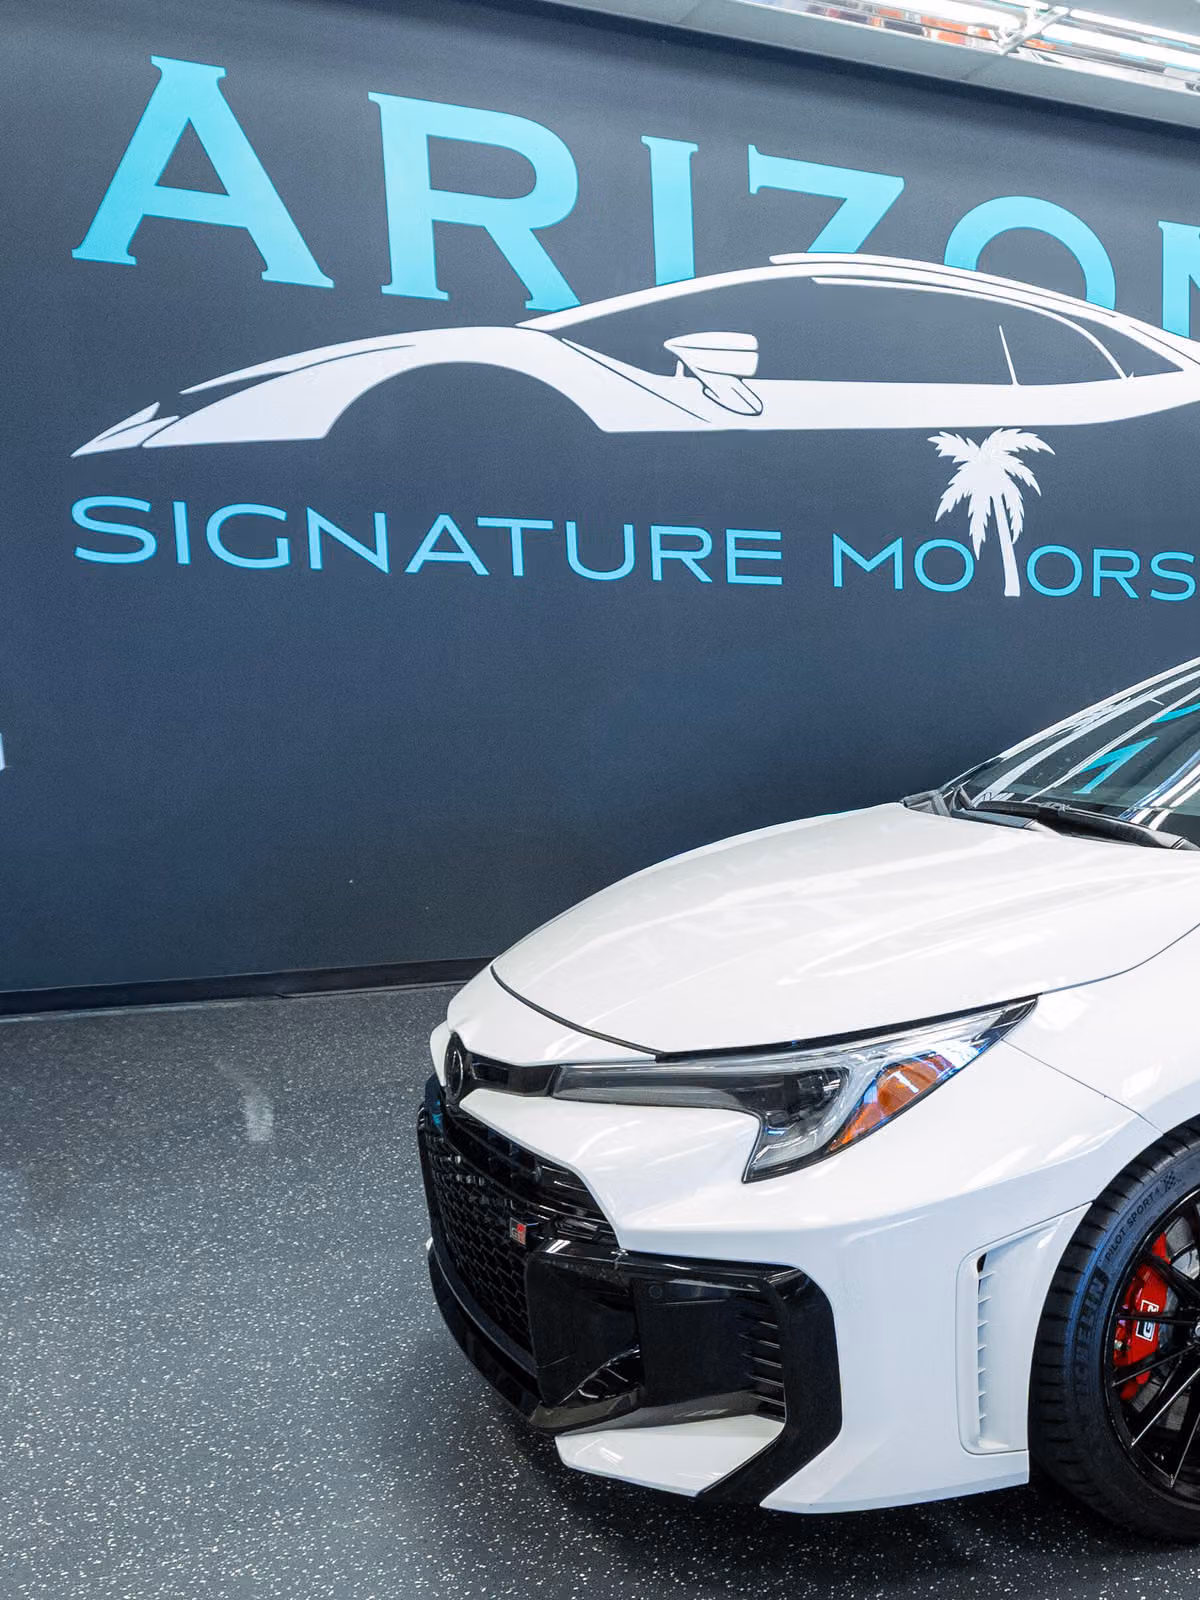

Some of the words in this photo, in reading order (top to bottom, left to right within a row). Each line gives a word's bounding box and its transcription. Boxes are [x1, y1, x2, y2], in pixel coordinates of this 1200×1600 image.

[70, 496, 783, 586] SIGNATURE
[1104, 1228, 1127, 1262] PILOT
[1126, 1191, 1155, 1227] SPORT
[1073, 1270, 1109, 1406] ICHELIN
